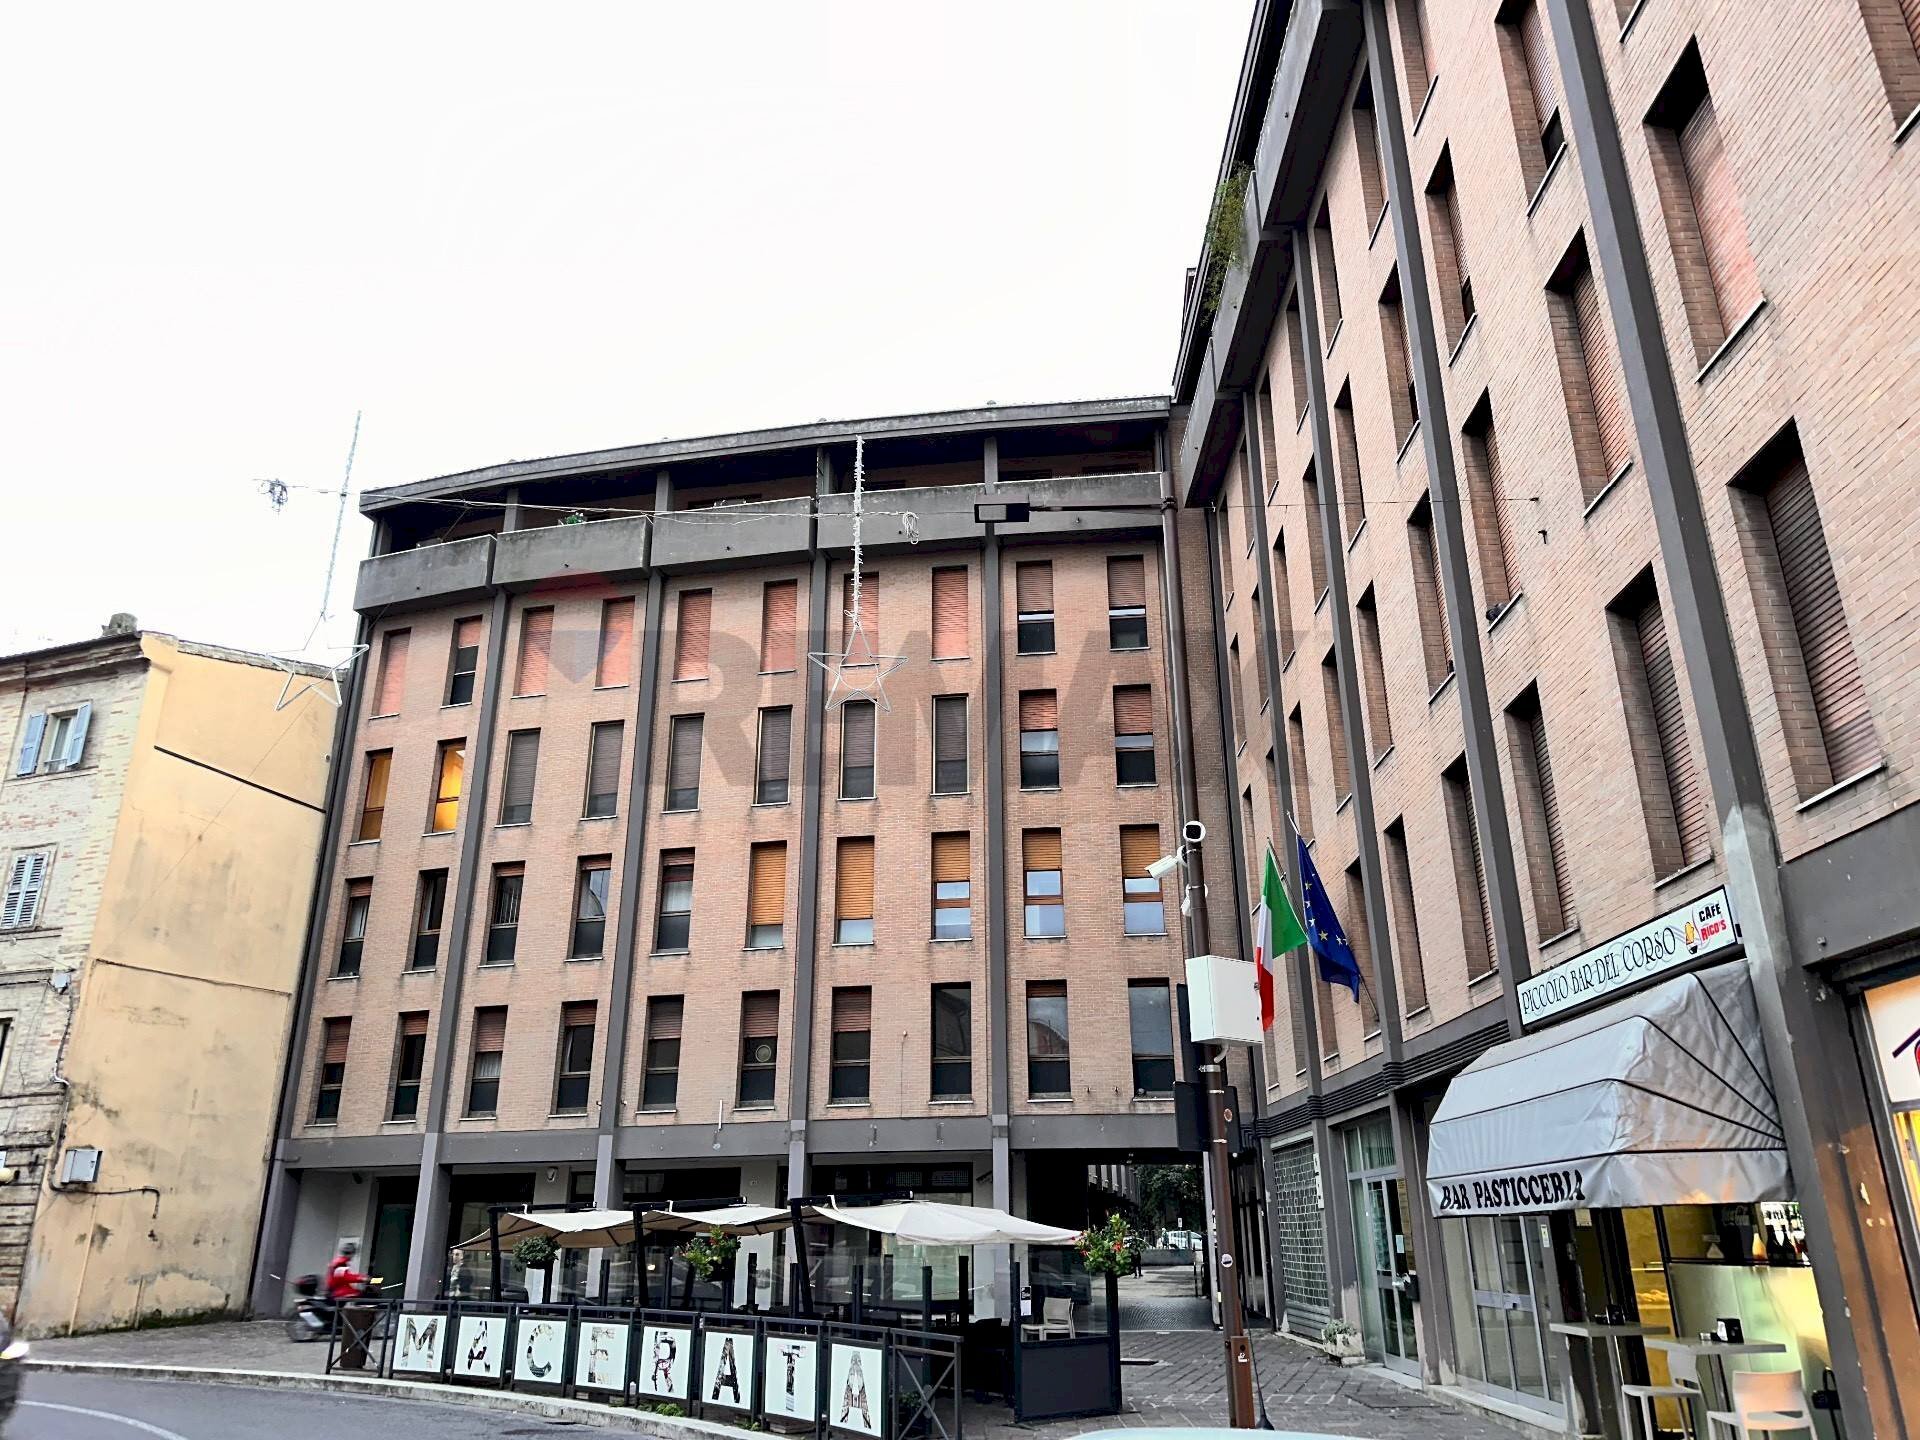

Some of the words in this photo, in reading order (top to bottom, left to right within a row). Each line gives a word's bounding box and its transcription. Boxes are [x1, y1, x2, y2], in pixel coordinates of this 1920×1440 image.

[1700, 919, 1727, 941] RICO'S
[1521, 975, 1570, 1015] PICCOLO
[1570, 963, 1594, 995] BAR
[1594, 952, 1620, 984] DEL
[1622, 927, 1676, 972] CORSO
[1439, 1185, 1472, 1210] BAR
[1472, 1168, 1586, 1209] PASTICCERIA
[399, 1317, 872, 1430] MACERATA
